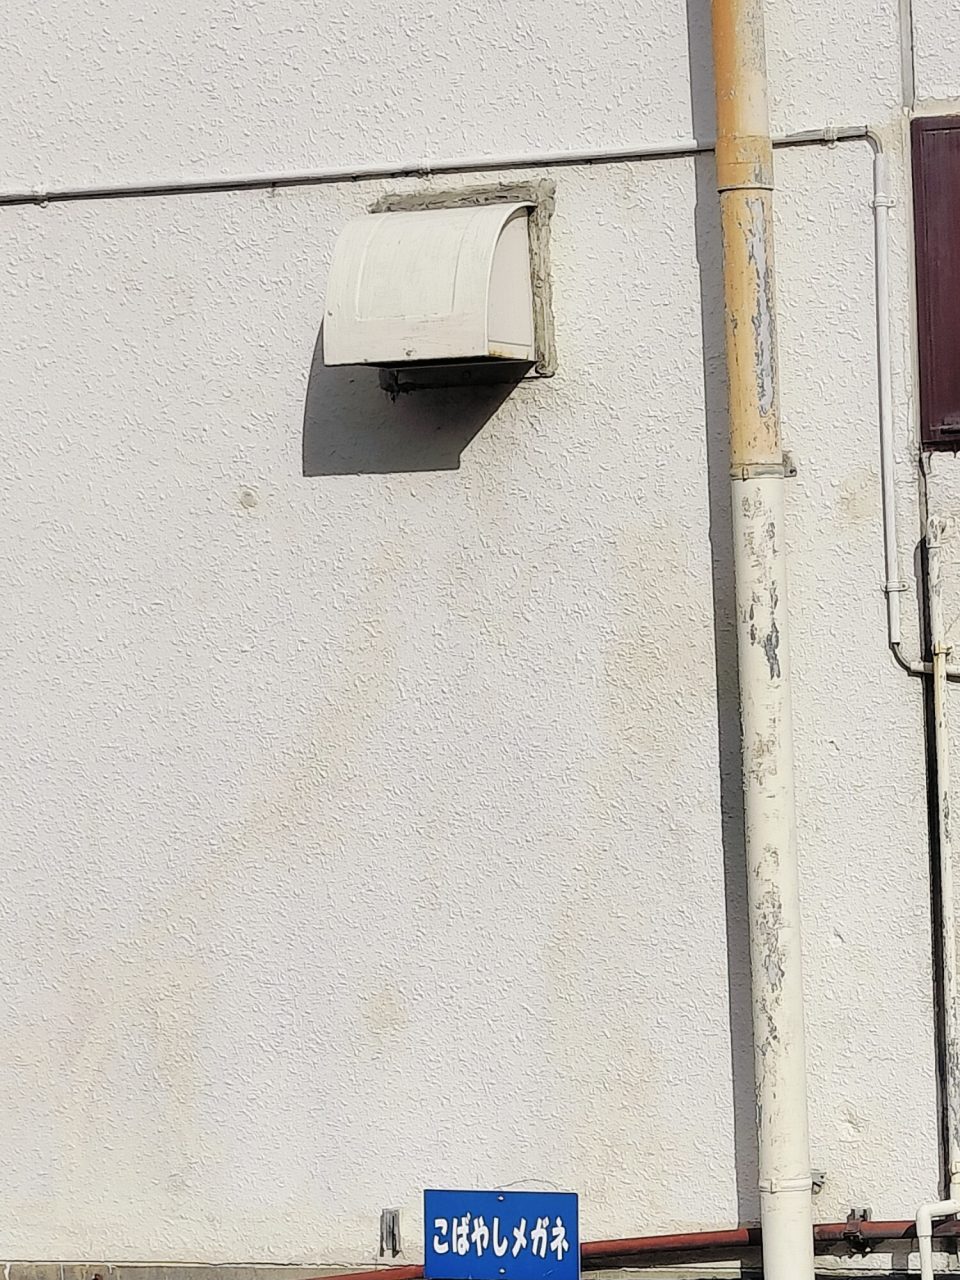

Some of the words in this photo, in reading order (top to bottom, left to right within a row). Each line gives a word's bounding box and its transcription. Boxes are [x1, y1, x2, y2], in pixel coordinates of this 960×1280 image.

[433, 1212, 570, 1261] こばやしメガネ
